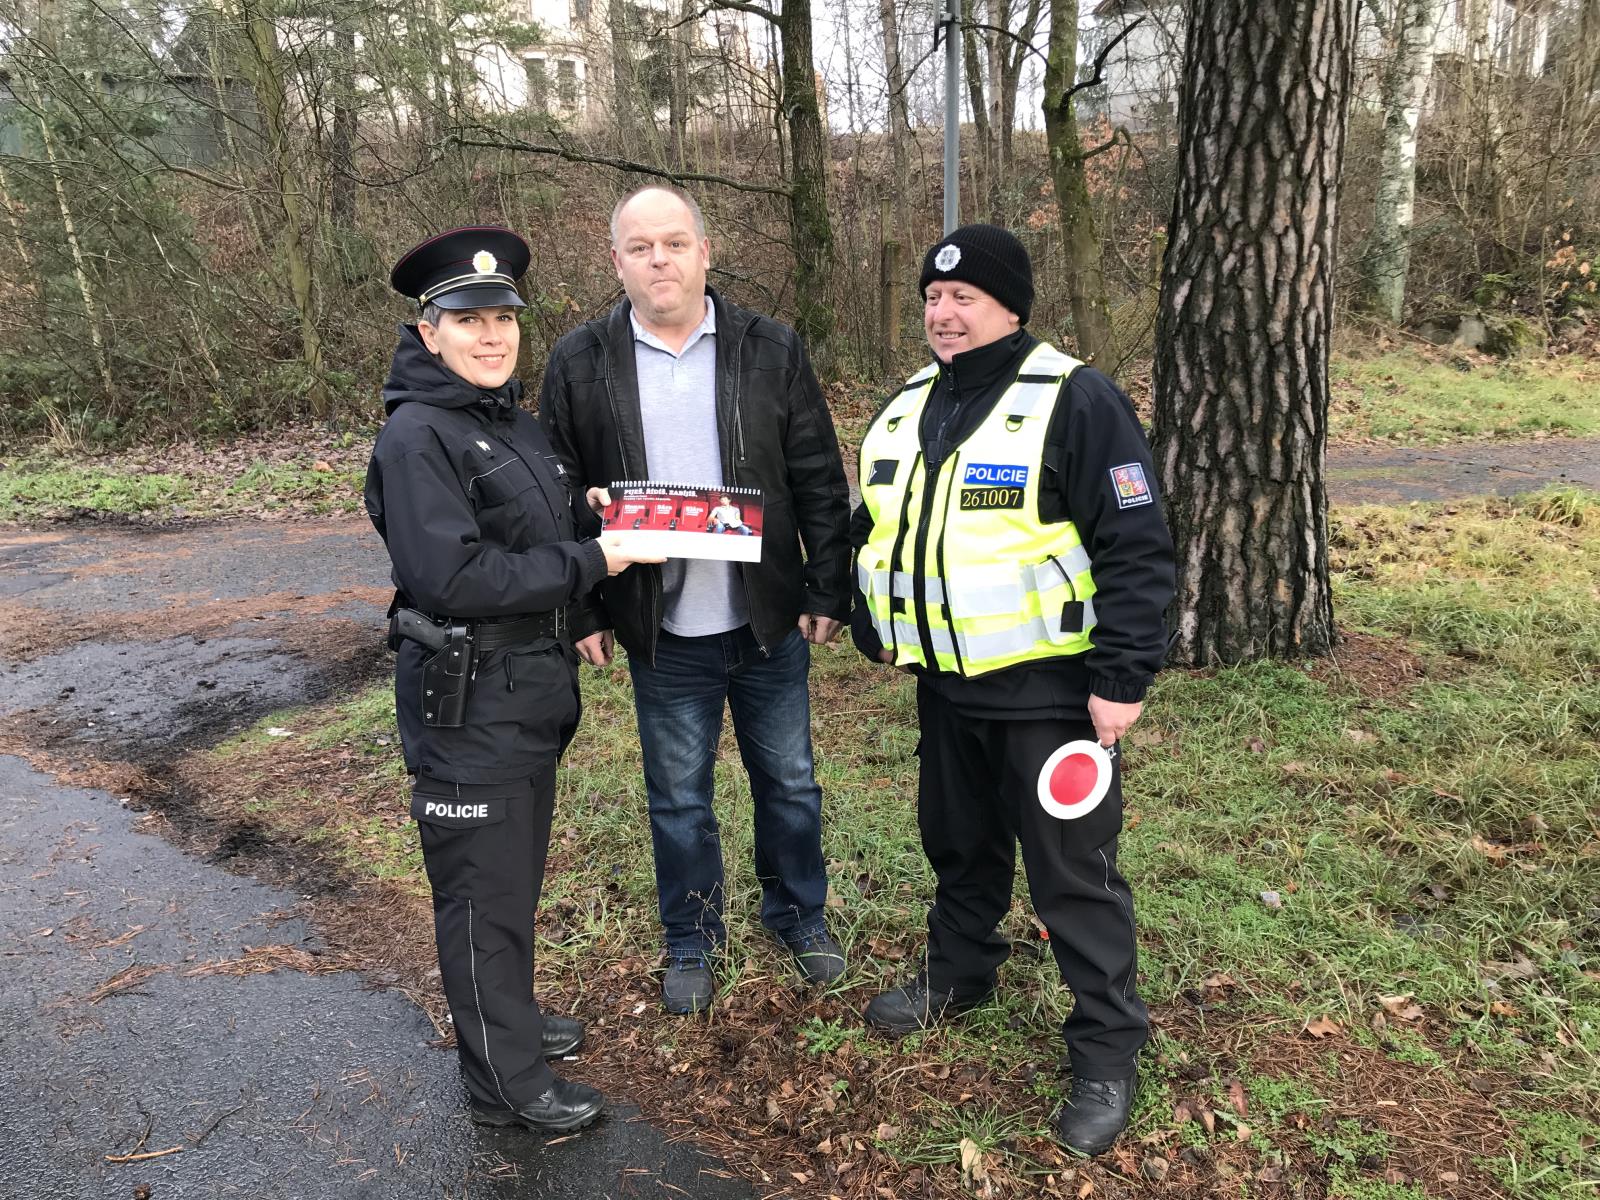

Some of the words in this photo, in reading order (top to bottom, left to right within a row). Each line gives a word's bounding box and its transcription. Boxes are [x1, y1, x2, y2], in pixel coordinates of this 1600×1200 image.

[965, 466, 1027, 483] POLICIE
[962, 489, 1020, 506] 261007
[1122, 494, 1149, 505] POLICIE
[425, 801, 489, 818] POLICIE
